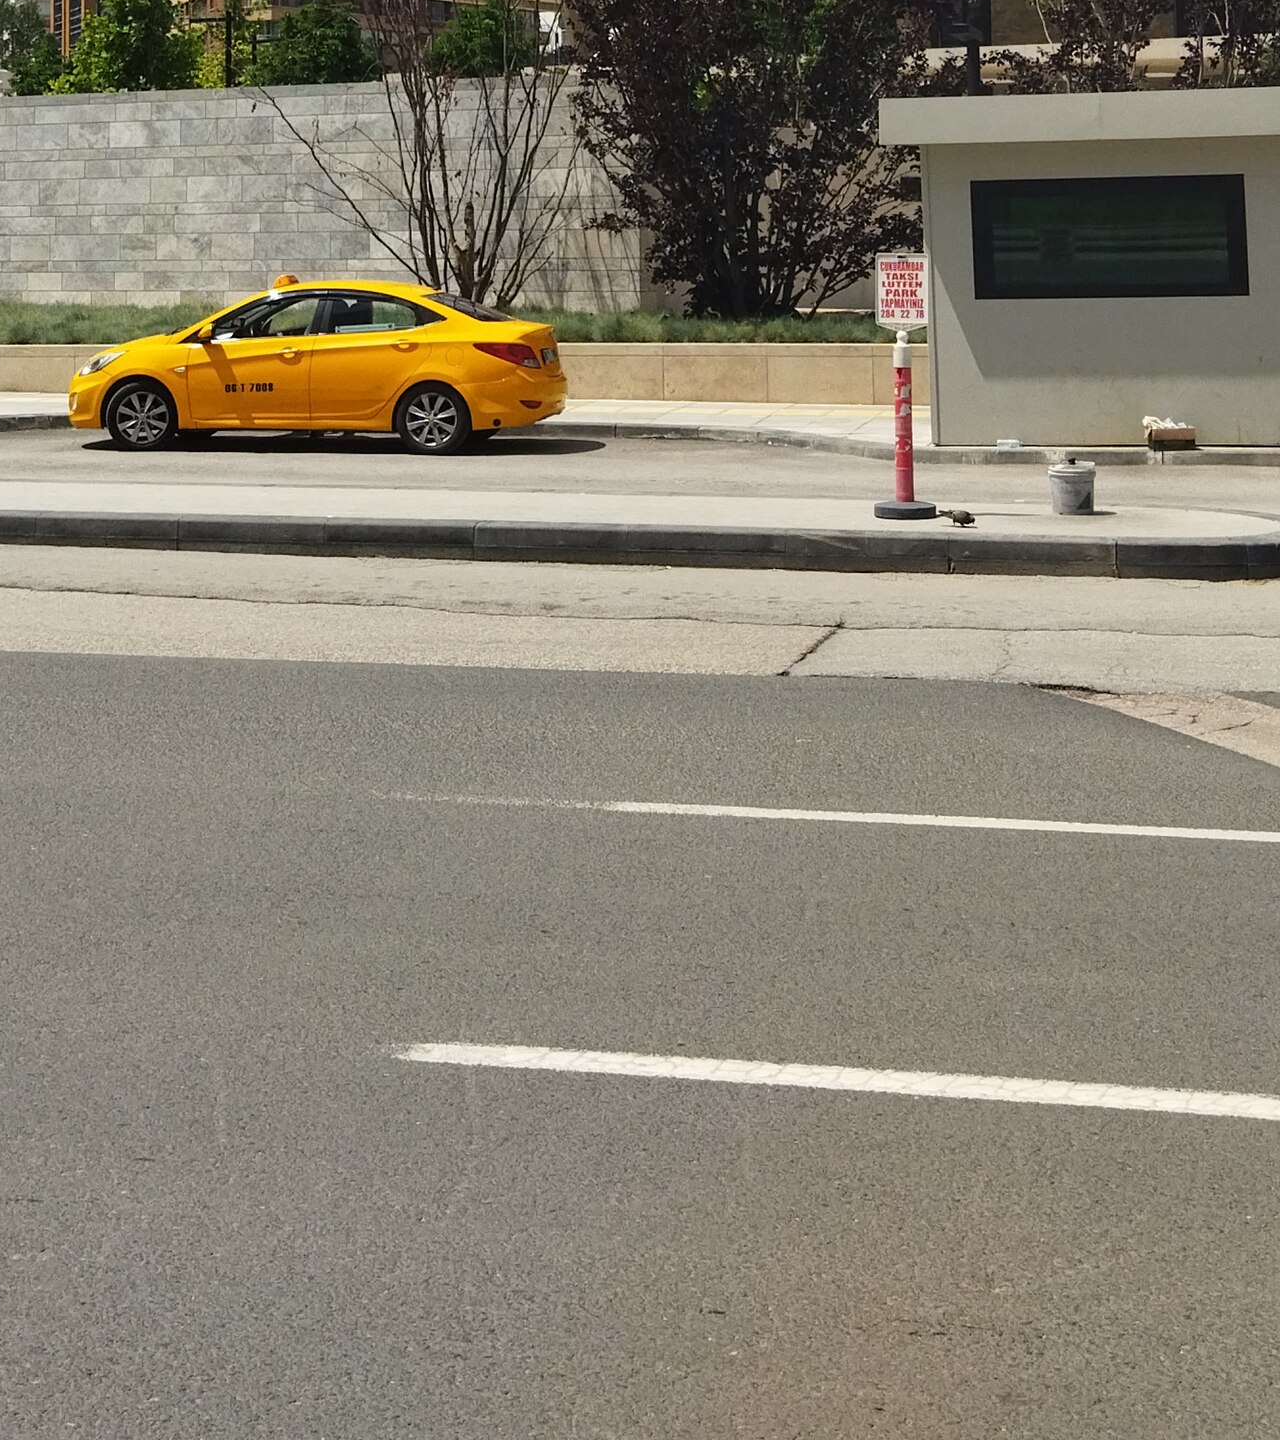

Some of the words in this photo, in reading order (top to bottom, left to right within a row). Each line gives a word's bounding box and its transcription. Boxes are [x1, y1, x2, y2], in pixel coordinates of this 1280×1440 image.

[885, 289, 918, 297] PARK
[880, 298, 924, 308] YAPMAYINIZ
[880, 309, 895, 318] 284
[900, 310, 910, 318] 22
[249, 382, 274, 392] 7008
